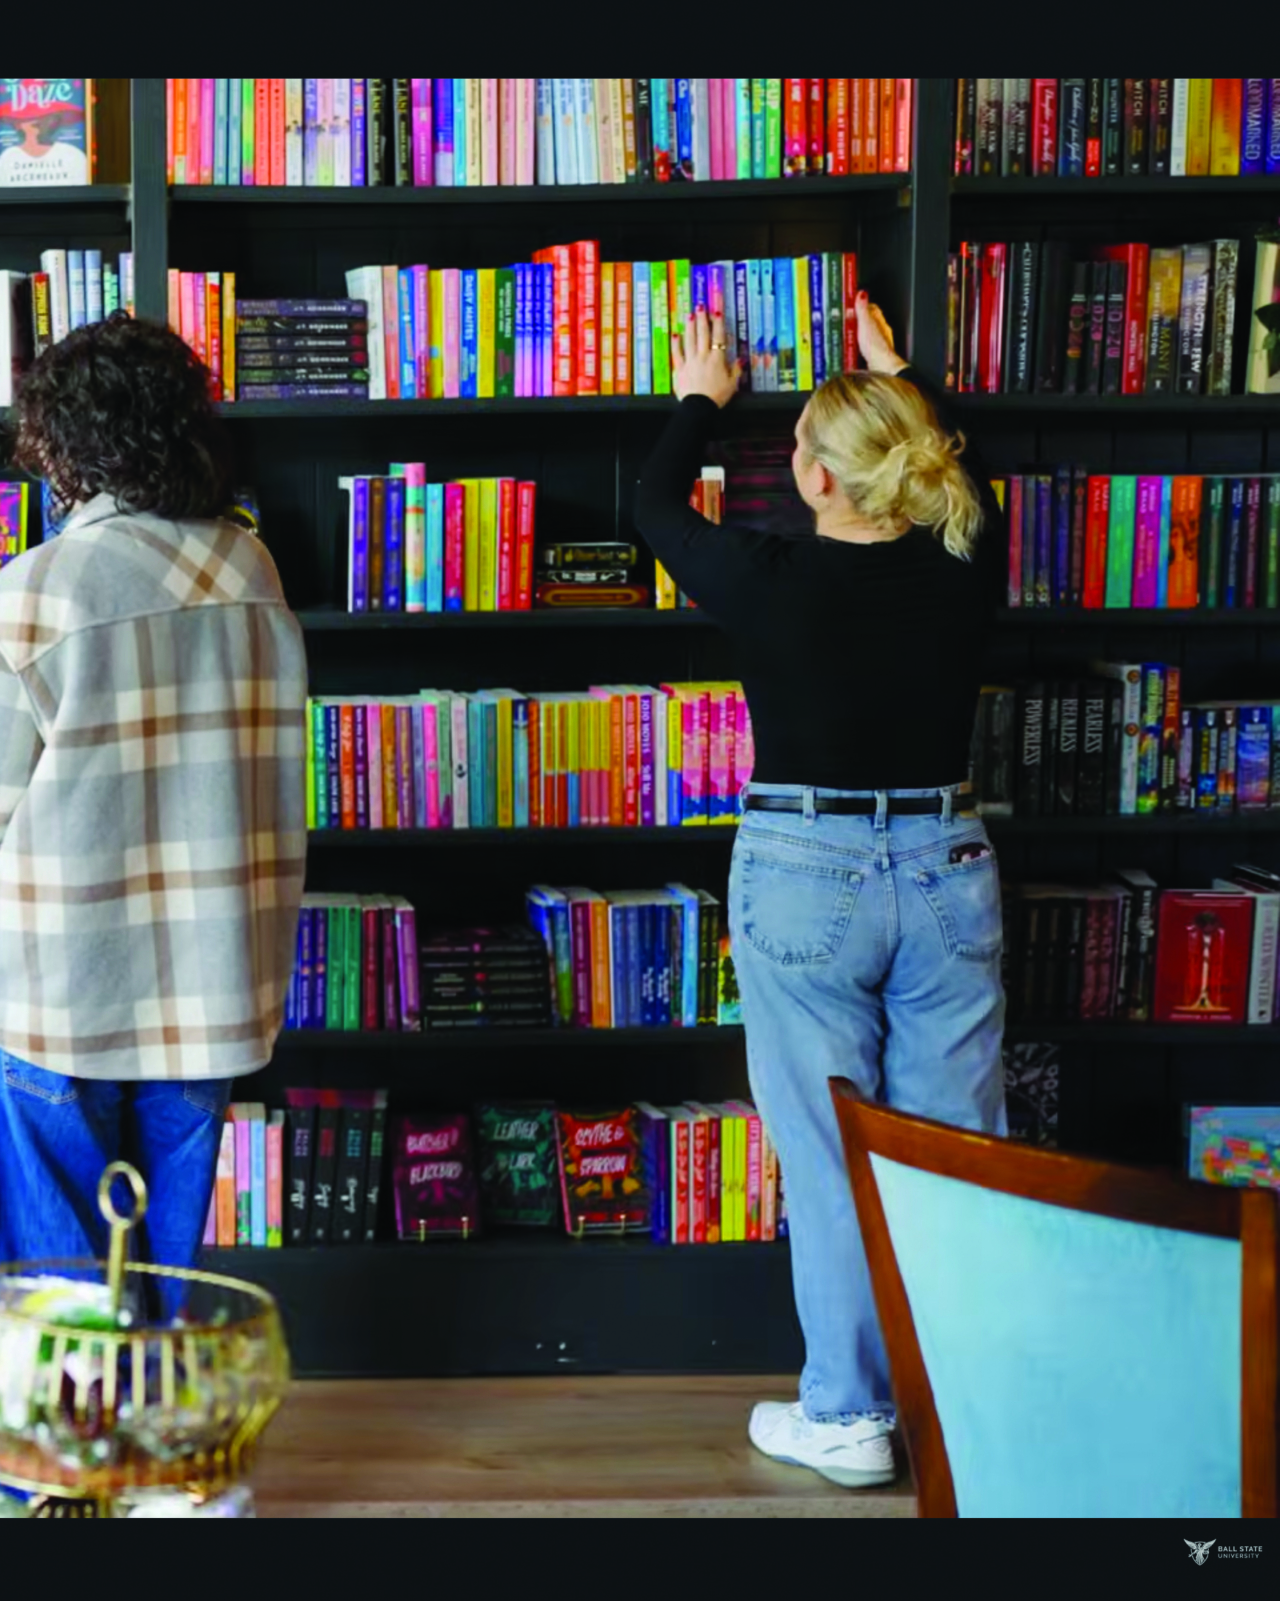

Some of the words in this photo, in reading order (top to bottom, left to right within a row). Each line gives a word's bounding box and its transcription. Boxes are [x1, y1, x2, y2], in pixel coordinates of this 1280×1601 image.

[6, 82, 73, 112] Daze
[1134, 81, 1143, 116] WITCH
[1158, 80, 1168, 115] WITCH
[1245, 79, 1263, 160] LOODMARKED
[1193, 274, 1208, 337] STRENGTH
[1191, 348, 1203, 374] FEW
[1023, 699, 1043, 766] POWERLESS
[1060, 698, 1077, 752] RECKLESS
[1084, 698, 1103, 753] FEARLESS
[493, 1119, 539, 1141] LEATHER
[575, 1125, 613, 1148] SCYTHE
[508, 1152, 536, 1170] LARK
